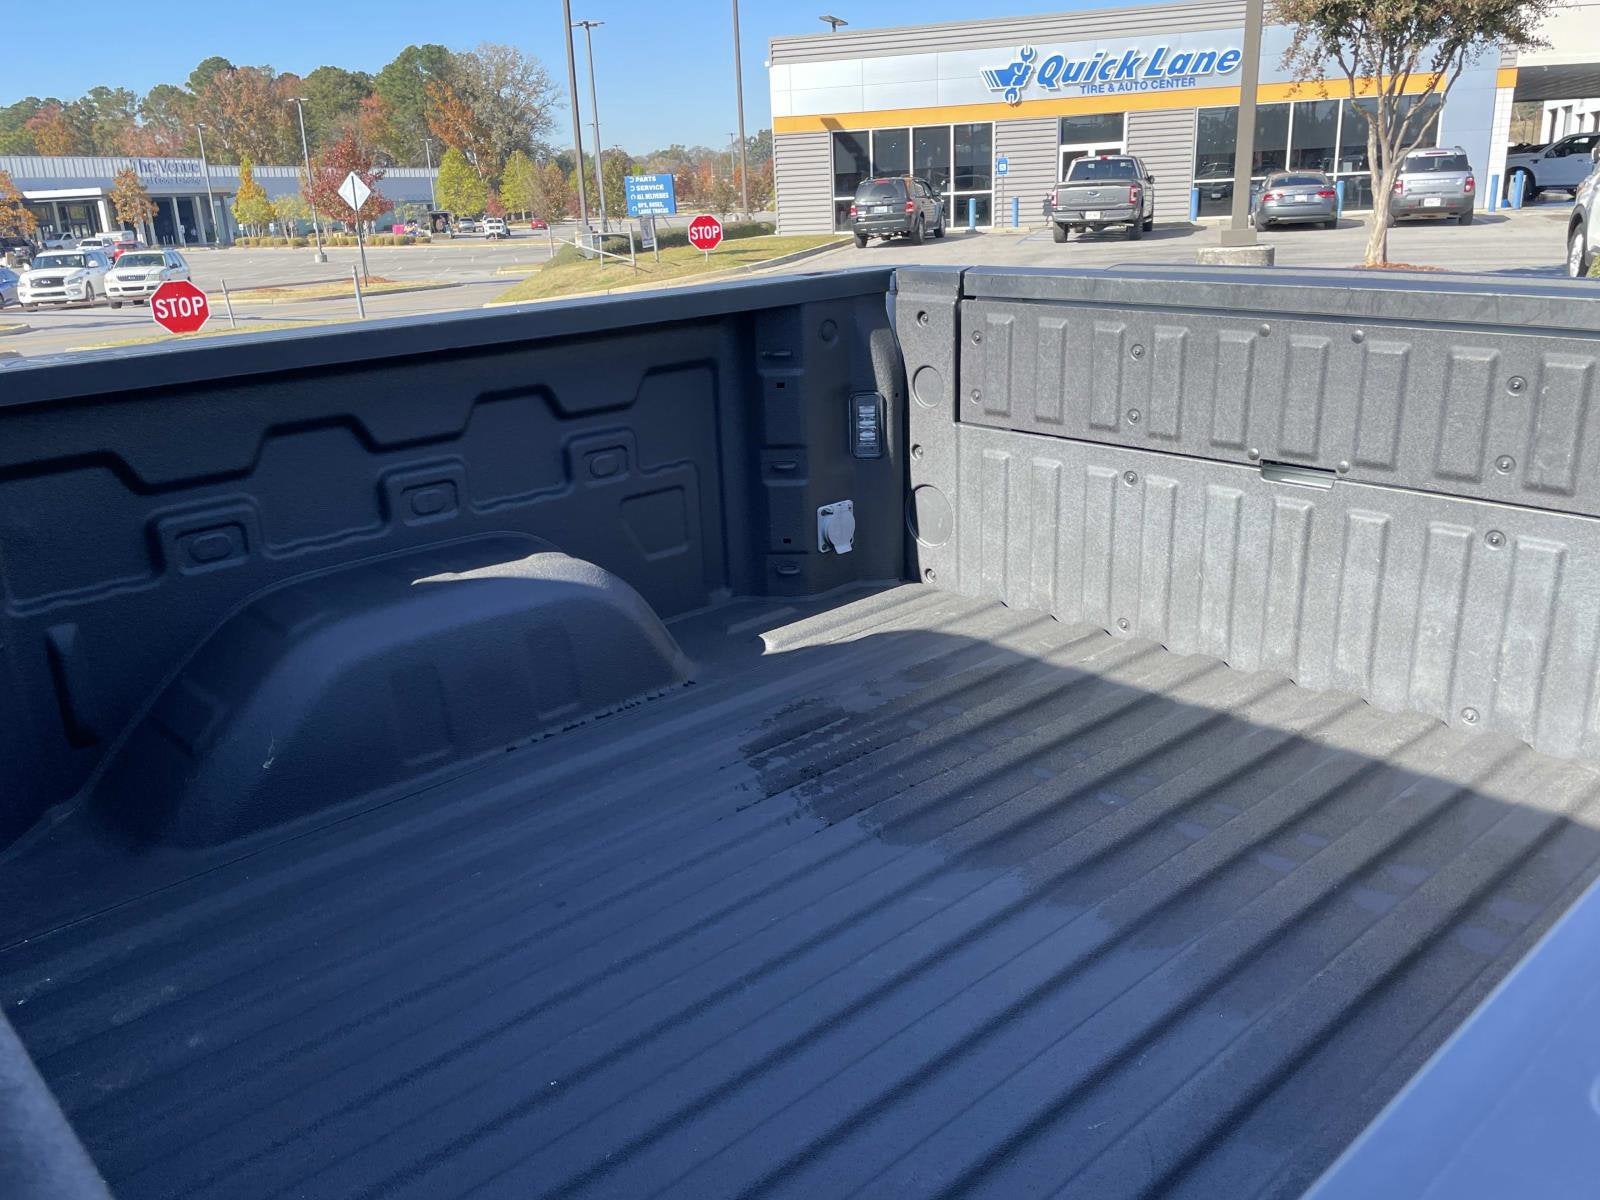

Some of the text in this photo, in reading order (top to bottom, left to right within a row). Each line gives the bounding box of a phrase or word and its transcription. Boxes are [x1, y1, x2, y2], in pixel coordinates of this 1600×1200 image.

[1037, 46, 1241, 88] Quick Lane
[1080, 77, 1196, 94] TIRE & AUTO CENTER
[158, 158, 199, 174] Venue
[691, 225, 719, 240] STOP
[155, 296, 204, 319] STOP
